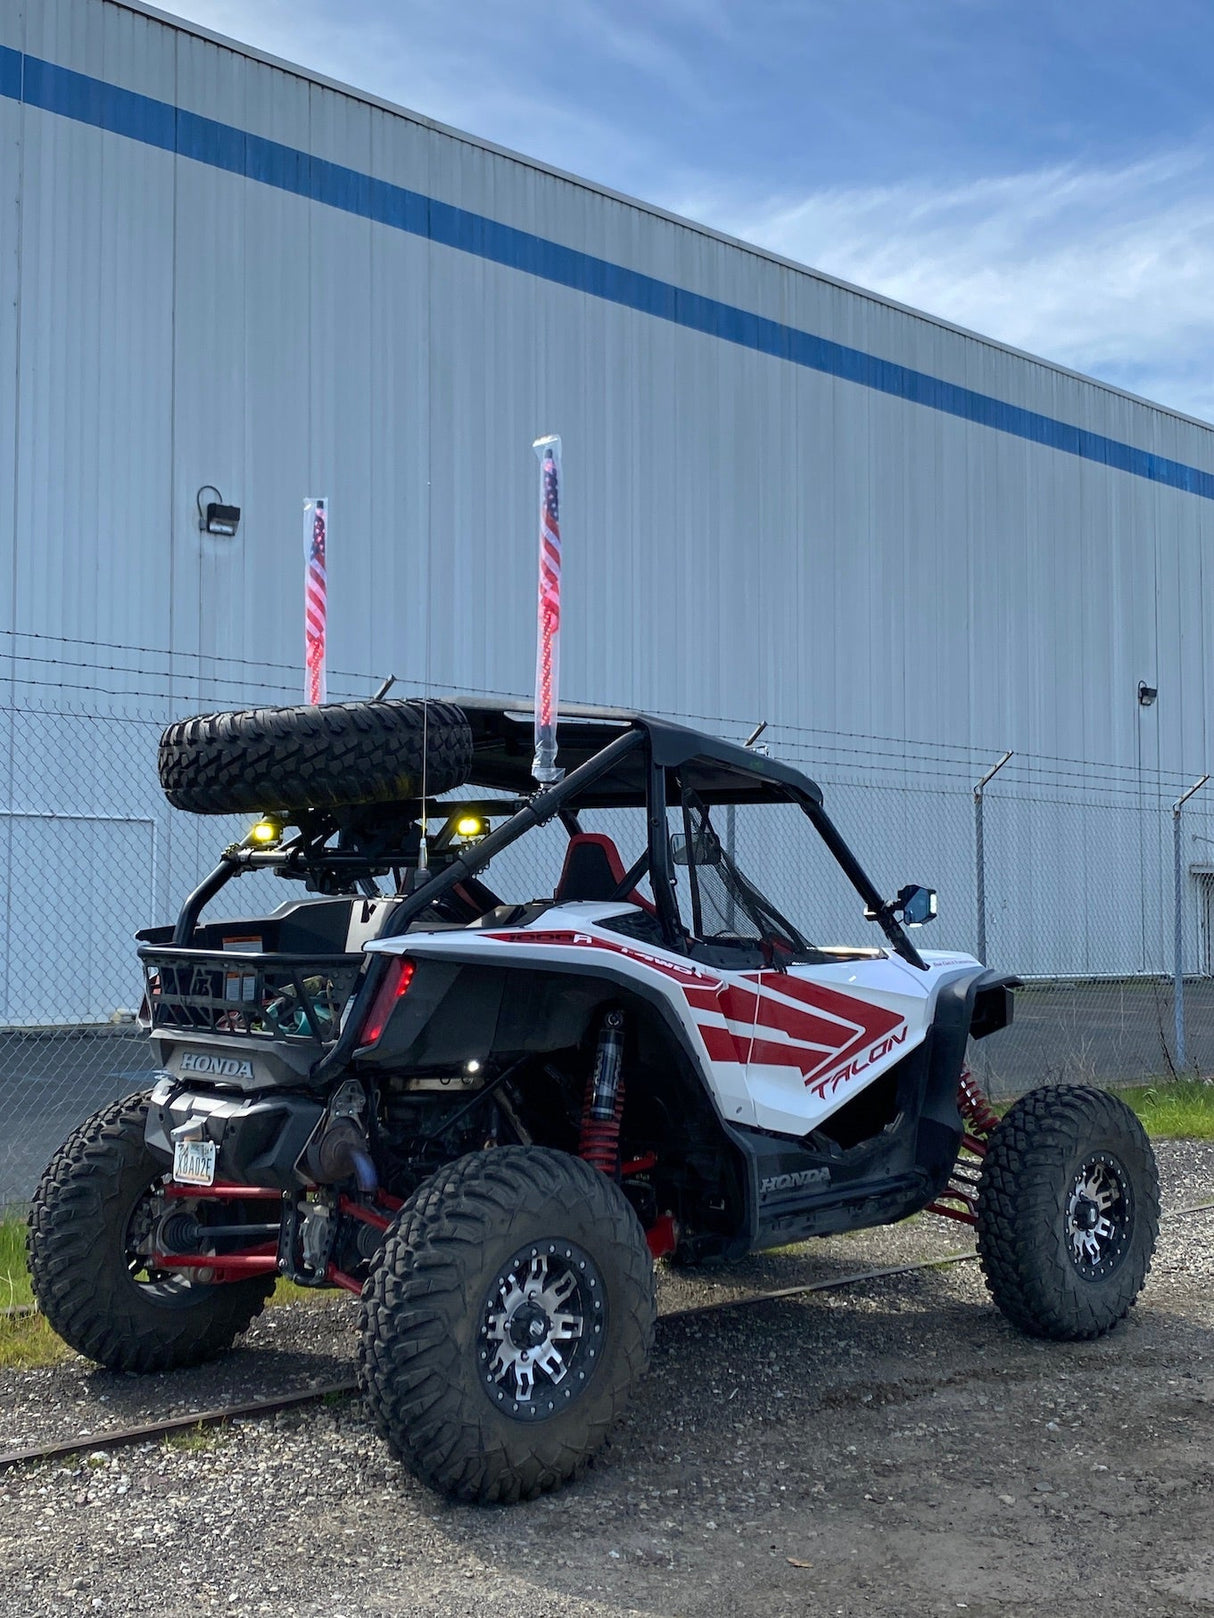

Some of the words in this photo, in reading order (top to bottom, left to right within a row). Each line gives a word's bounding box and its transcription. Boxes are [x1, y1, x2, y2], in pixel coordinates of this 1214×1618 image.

[180, 1052, 254, 1079] HONDA
[811, 1025, 908, 1100] TALON
[759, 1166, 832, 1194] HONDA
